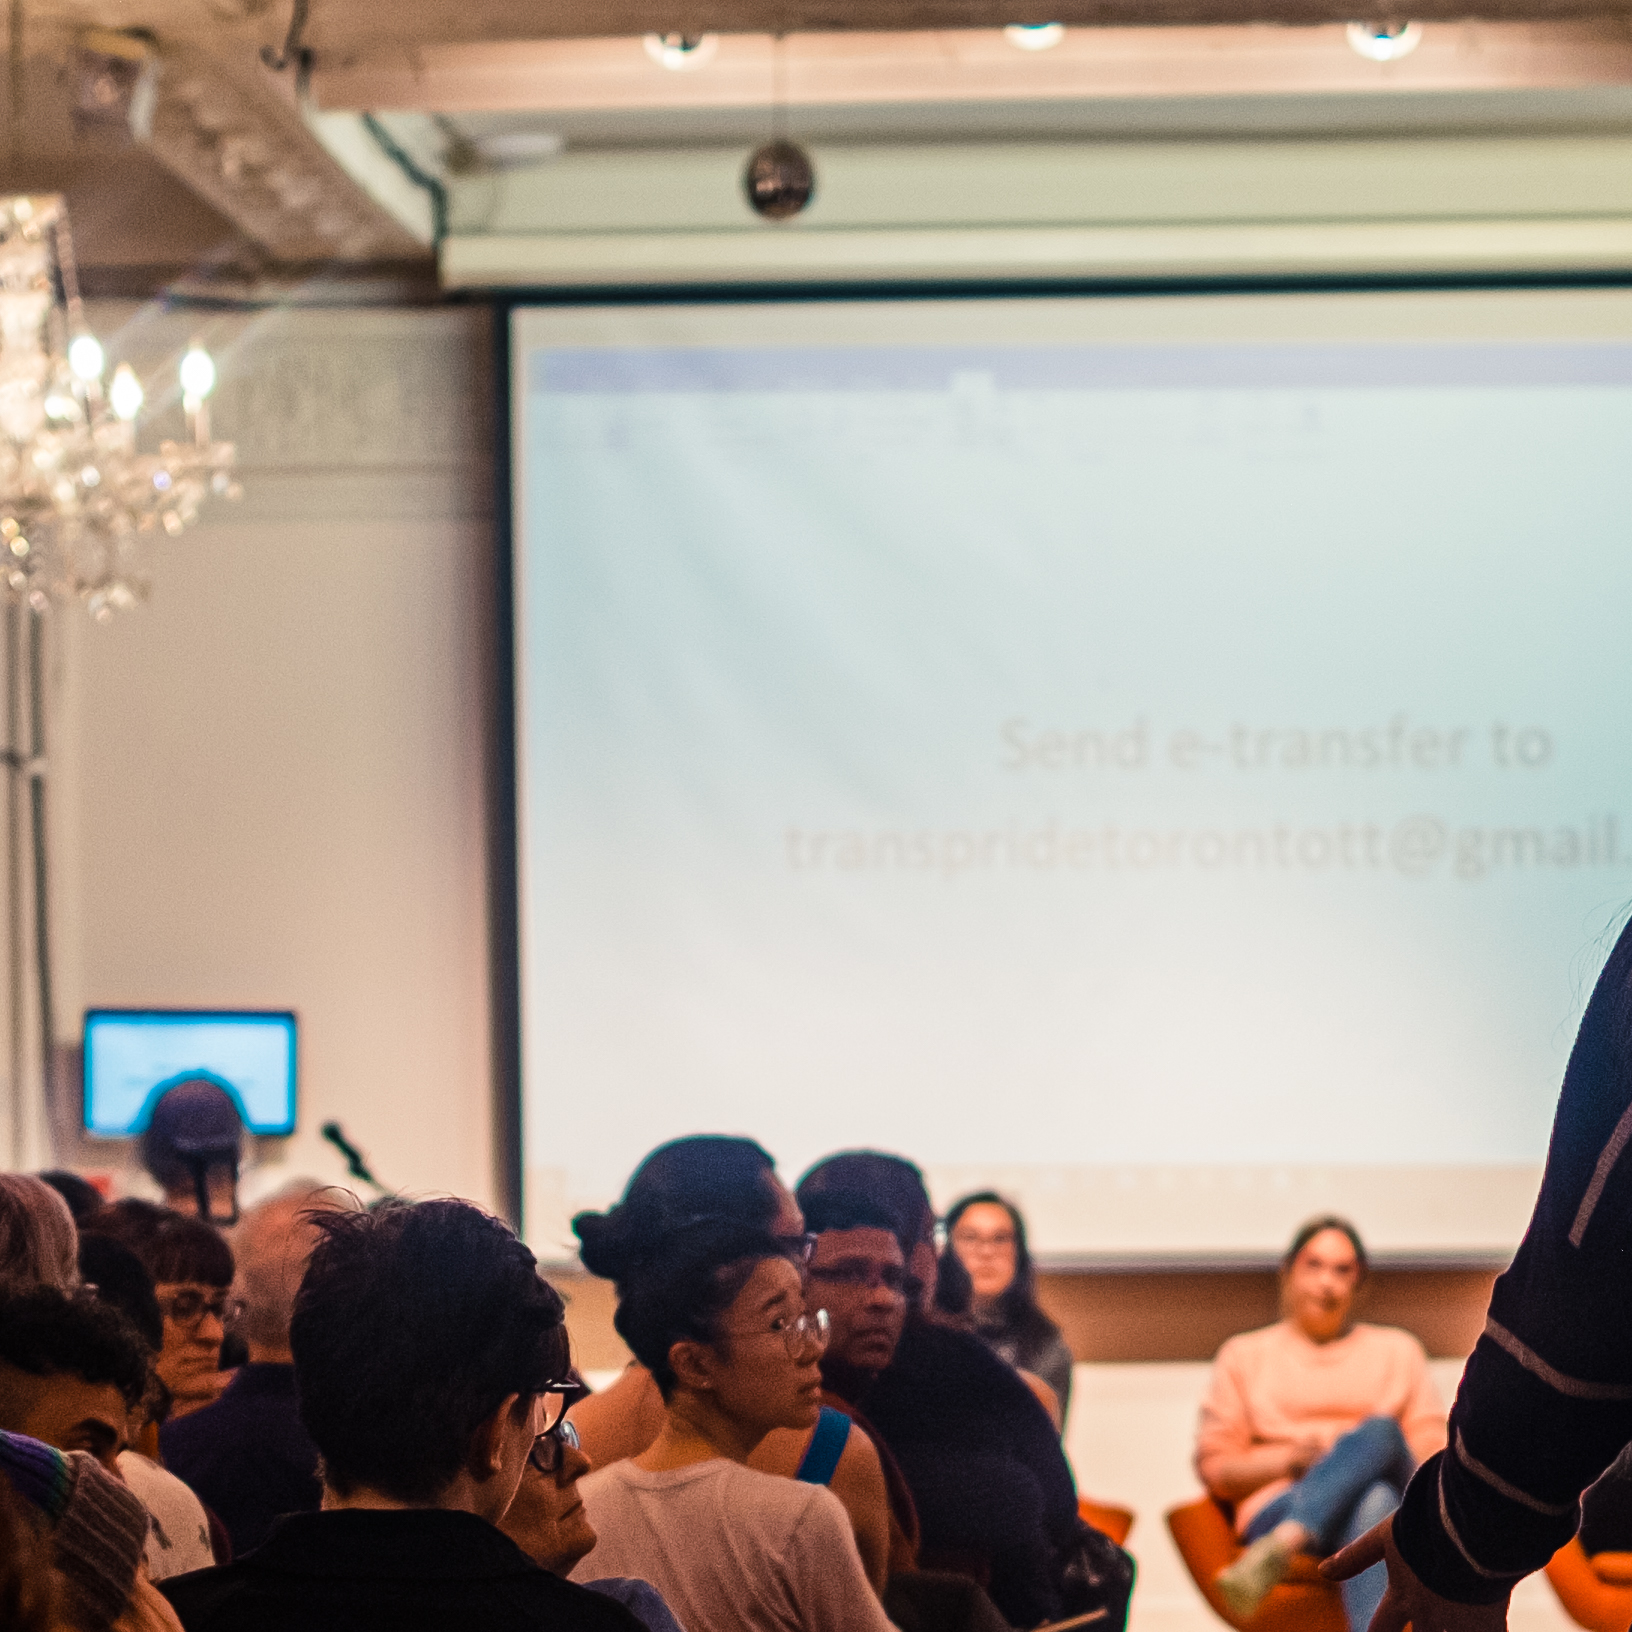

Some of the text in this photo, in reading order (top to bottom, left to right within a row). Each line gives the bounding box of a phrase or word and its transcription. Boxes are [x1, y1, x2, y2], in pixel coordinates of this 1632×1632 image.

[997, 710, 1556, 771] Send e-transfer to
